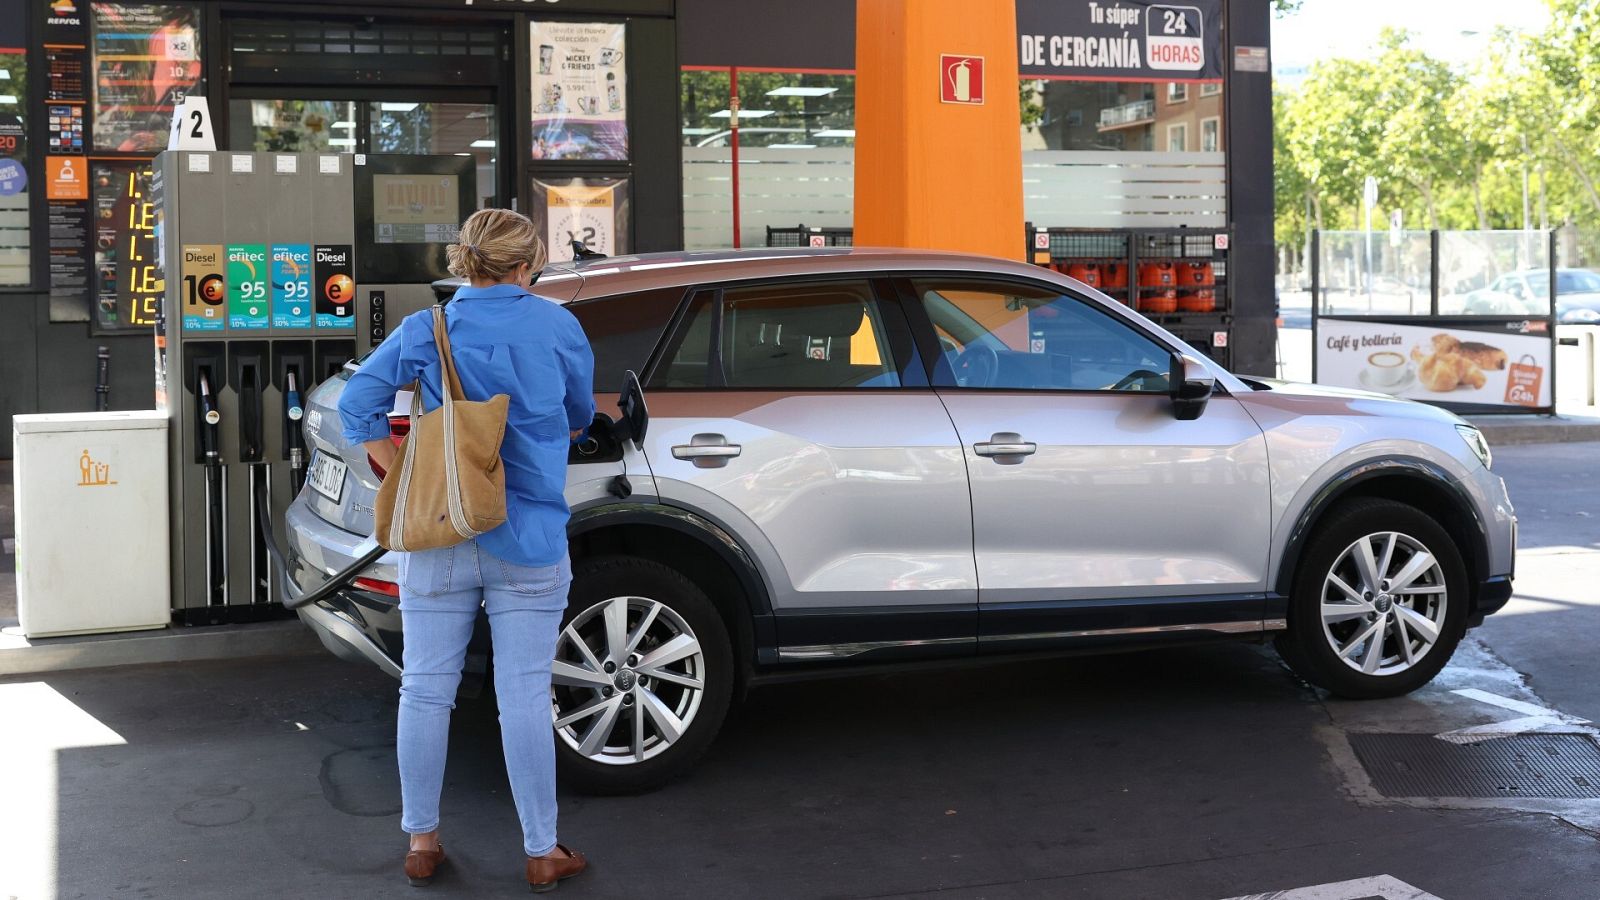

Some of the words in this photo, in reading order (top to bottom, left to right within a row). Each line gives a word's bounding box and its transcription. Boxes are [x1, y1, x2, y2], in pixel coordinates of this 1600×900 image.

[47, 17, 80, 25] REPSOL
[1088, 2, 1104, 24] Tu
[1106, 2, 1141, 29] súper
[1163, 10, 1187, 35] 24
[174, 42, 187, 50] x2
[1021, 34, 1046, 66] DE
[1050, 31, 1141, 69] CERCANÍA
[1151, 44, 1200, 63] HORAS
[170, 67, 183, 77] 10
[170, 91, 184, 101] 15
[190, 110, 203, 138] 2
[386, 183, 447, 206] NAVIDAD
[566, 227, 596, 246] x2
[185, 252, 216, 262] Diesel
[229, 252, 265, 262] efitec
[273, 252, 309, 262] efitec
[316, 252, 346, 262] Diesel
[240, 281, 266, 299] 95
[284, 281, 309, 298] 95
[185, 321, 201, 329] 10%
[1326, 335, 1350, 352] Café
[1352, 338, 1359, 349] y
[1361, 333, 1402, 347] bollería
[1511, 391, 1534, 402] 24h
